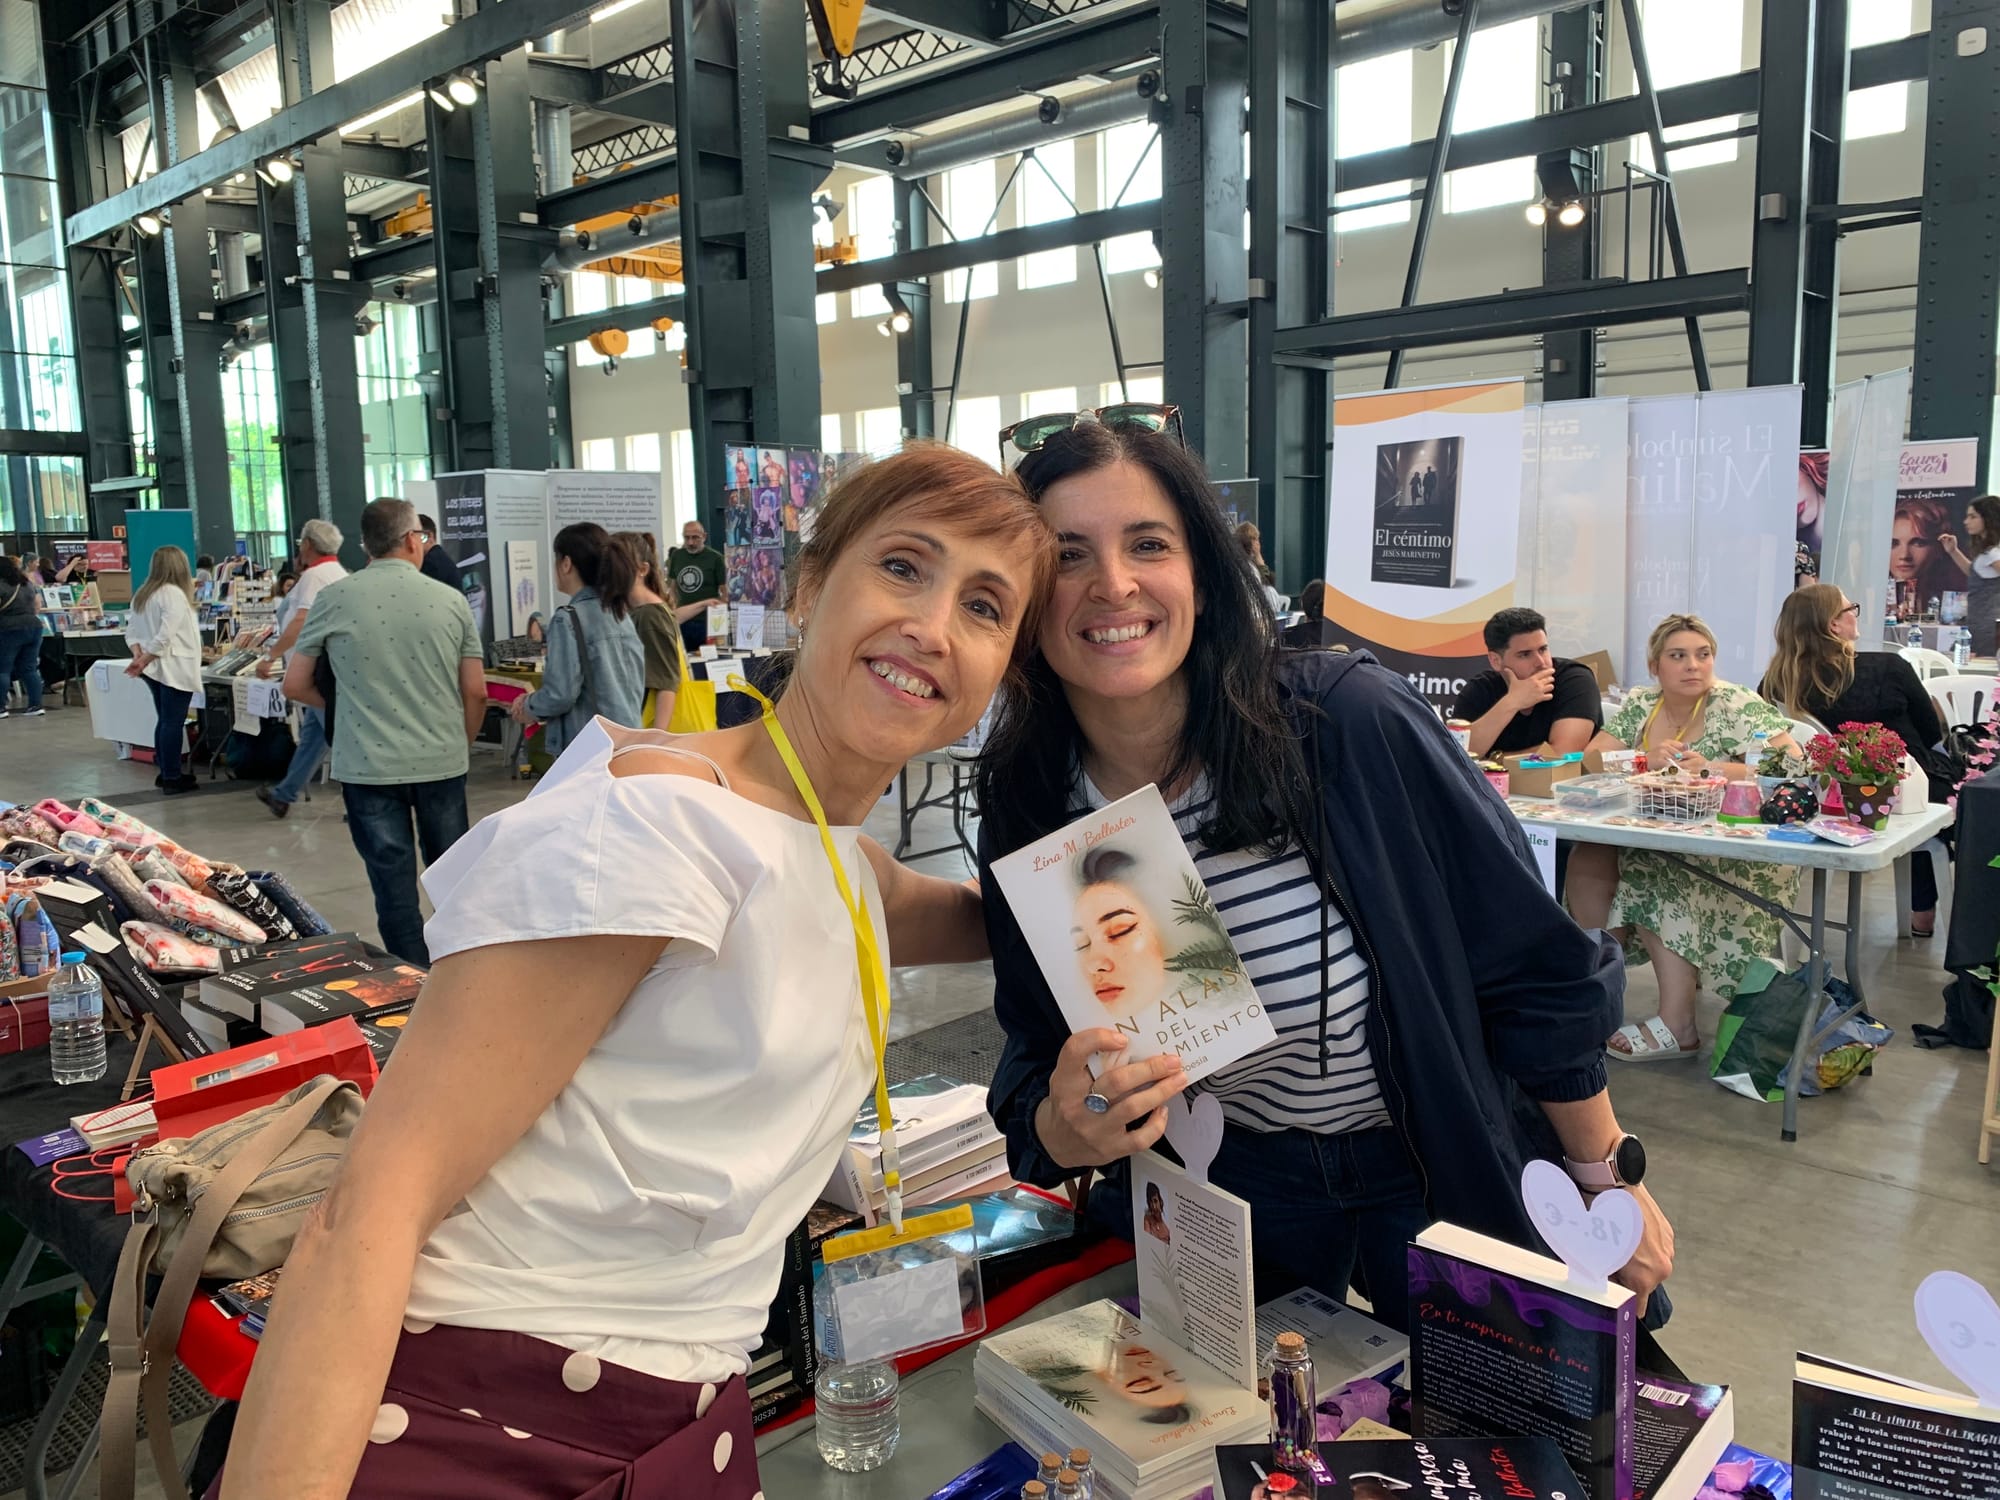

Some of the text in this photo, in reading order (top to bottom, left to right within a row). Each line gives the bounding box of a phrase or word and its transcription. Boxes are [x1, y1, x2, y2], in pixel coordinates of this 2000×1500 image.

[1375, 529, 1452, 549] El céntimo
[1382, 550, 1441, 559] JESÚS MARINETTO
[1033, 854, 1063, 872] Lina
[1083, 815, 1137, 848] Ballester
[1115, 965, 1239, 1035] N ALAS
[1155, 1017, 1197, 1045] DEL
[1175, 1004, 1261, 1058] MIENTO
[801, 1324, 809, 1341] del
[1464, 1320, 1515, 1345] empresa
[804, 1341, 813, 1372] busca
[806, 1372, 814, 1385] En
[1833, 1418, 1855, 1430] Esta
[1858, 1424, 1889, 1438] novela
[1892, 1433, 1964, 1453] contemporánea
[1968, 1448, 1989, 1458] está
[1926, 1423, 1941, 1434] DE
[1819, 1426, 1853, 1442] trabajo
[1855, 1434, 1866, 1444] de
[1867, 1437, 1881, 1447] los
[1883, 1442, 1931, 1459] asistentes
[1933, 1452, 1971, 1466] sociales
[1971, 1460, 1979, 1469] y
[1979, 1462, 1992, 1470] en
[1819, 1437, 1831, 1447] de
[1836, 1441, 1850, 1451] las
[1856, 1448, 1899, 1463] personas
[1917, 1460, 1932, 1470] las
[1938, 1467, 1956, 1475] que
[1962, 1471, 2000, 1483] ayudan,
[1818, 1450, 1861, 1467] protegen
[1872, 1463, 1881, 1471] al
[1892, 1468, 1949, 1485] encontrarse
[1960, 1482, 1973, 1490] en
[1818, 1461, 1885, 1484] vulnerabilidad
[1894, 1480, 1906, 1488] en
[1907, 1482, 1942, 1496] peligro
[1942, 1488, 1954, 1498] de
[1820, 1488, 1829, 1498] la
[1835, 1481, 1856, 1494] Bajo
[1858, 1486, 1867, 1495] el
